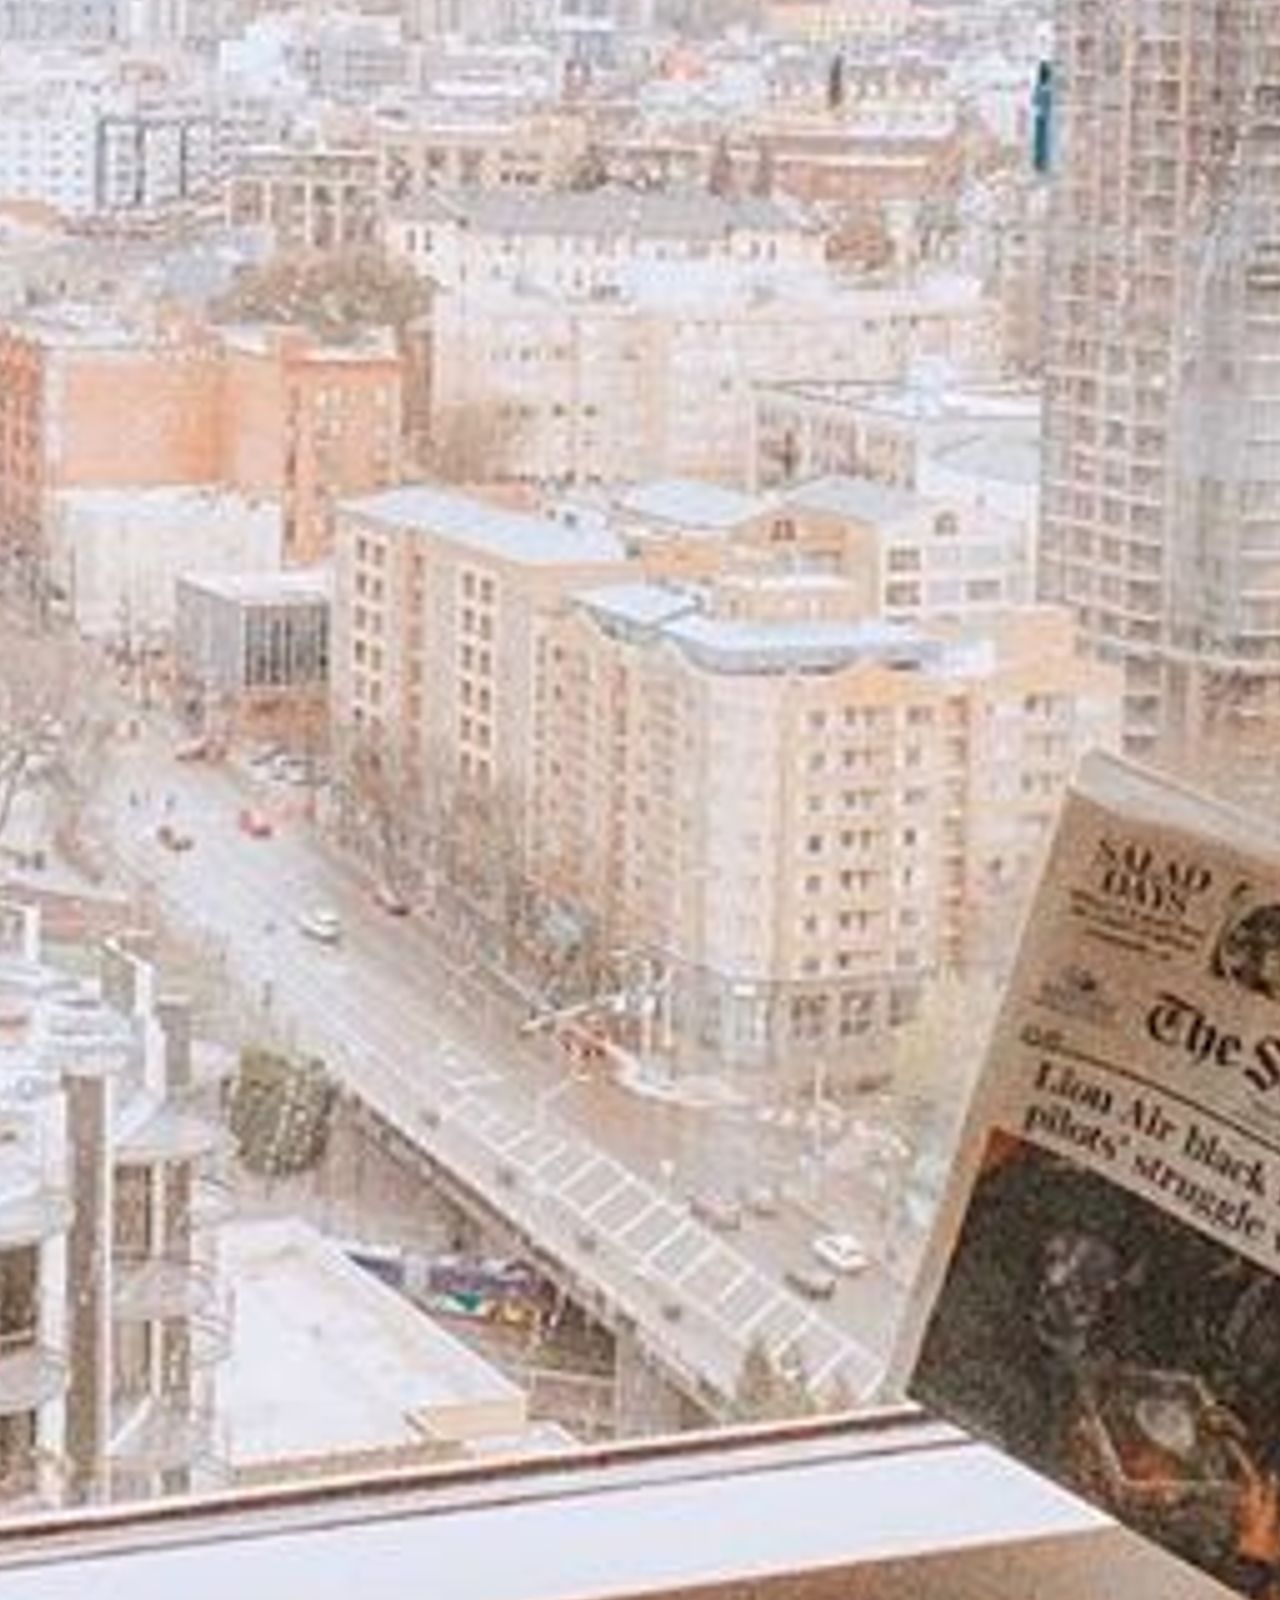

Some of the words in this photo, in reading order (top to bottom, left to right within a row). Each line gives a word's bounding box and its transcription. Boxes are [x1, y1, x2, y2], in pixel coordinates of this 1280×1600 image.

[1101, 868, 1187, 914] DAYS
[1145, 990, 1242, 1066] The
[1032, 1059, 1114, 1116] Lion
[1119, 1097, 1178, 1144] Air
[1182, 1122, 1270, 1199] black
[1131, 1147, 1267, 1244] struggle
